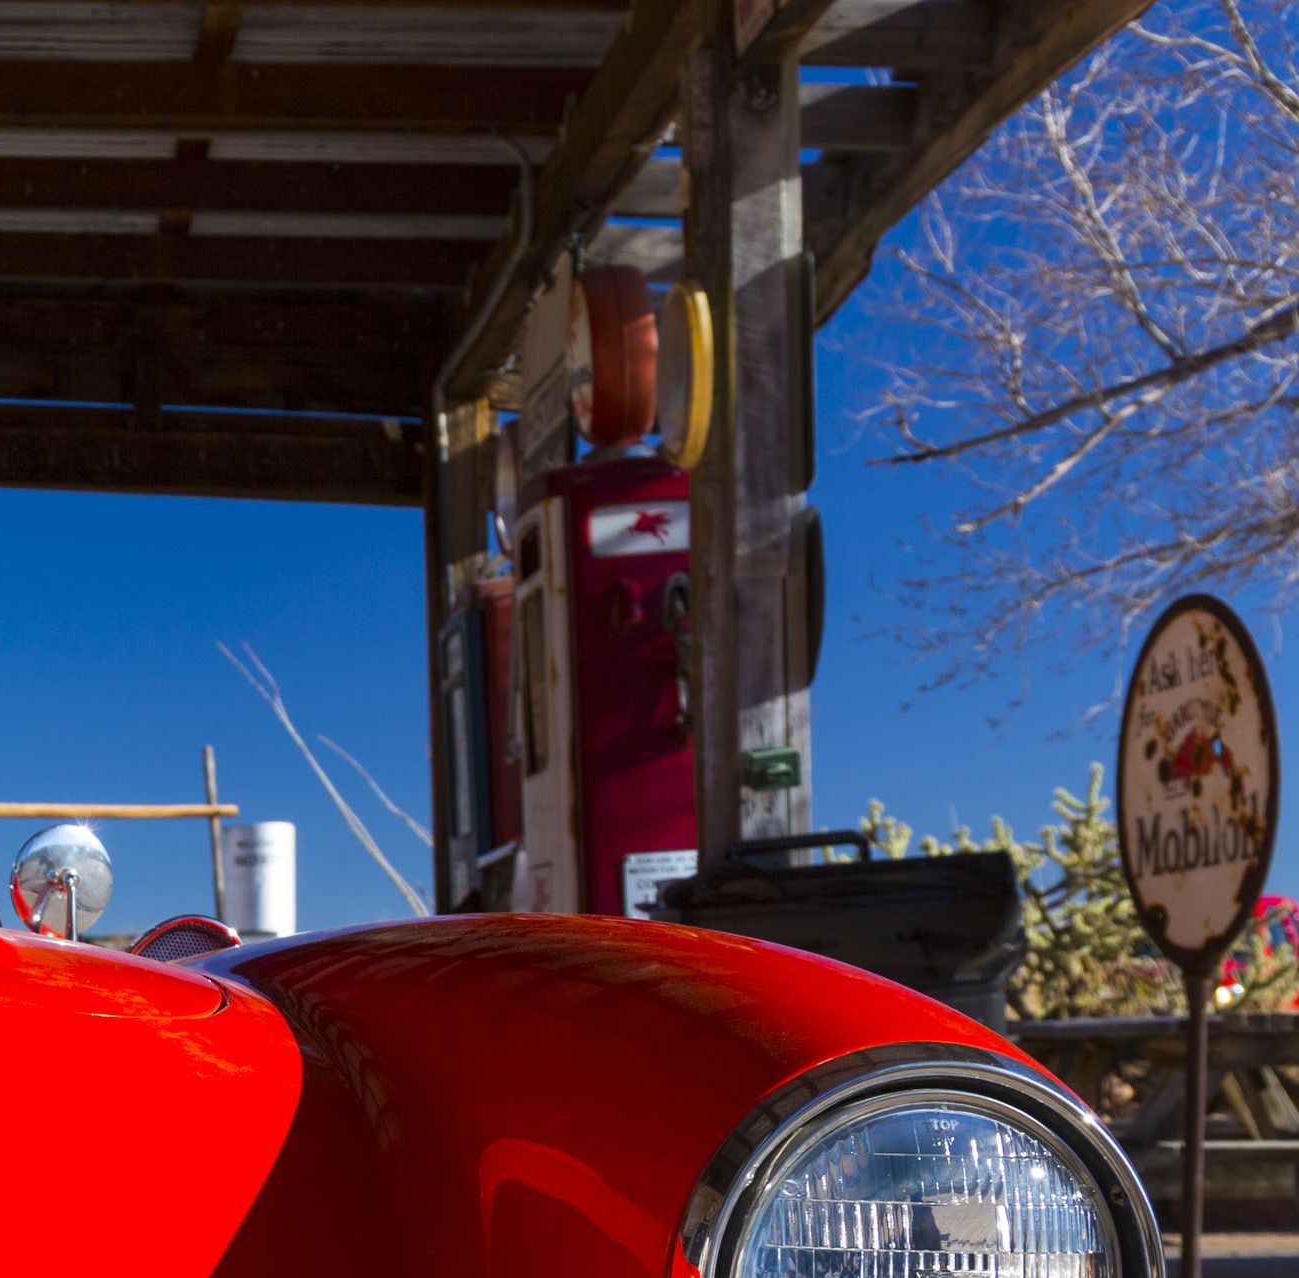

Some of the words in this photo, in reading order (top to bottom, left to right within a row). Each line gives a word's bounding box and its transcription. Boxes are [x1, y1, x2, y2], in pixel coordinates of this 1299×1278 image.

[1147, 649, 1183, 695] Ask
[1136, 791, 1259, 879] Mobiloil
[930, 1119, 959, 1131] TOP
